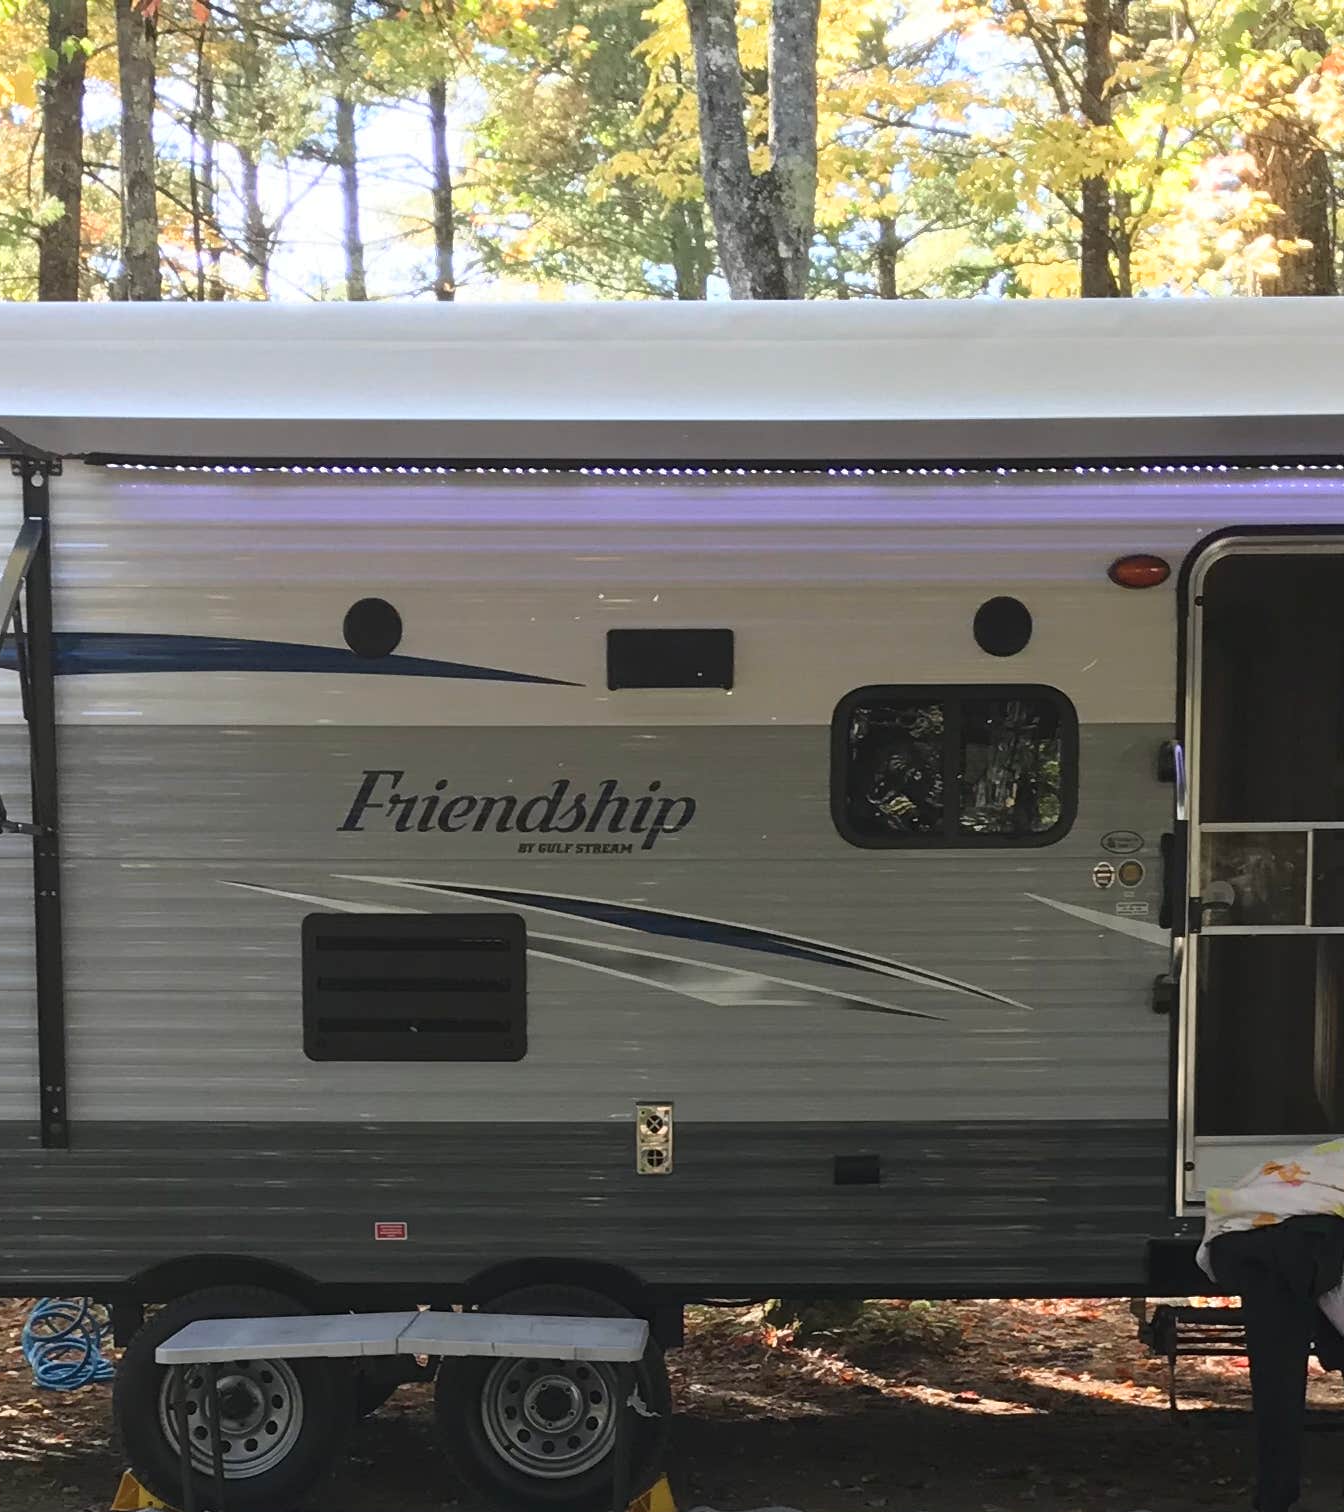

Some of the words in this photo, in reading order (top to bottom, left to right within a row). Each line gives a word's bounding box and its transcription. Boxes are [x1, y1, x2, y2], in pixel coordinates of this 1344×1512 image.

[336, 769, 697, 850] Friendship
[517, 843, 536, 854] BY
[537, 843, 574, 854] GULF
[575, 843, 634, 854] STREAM
